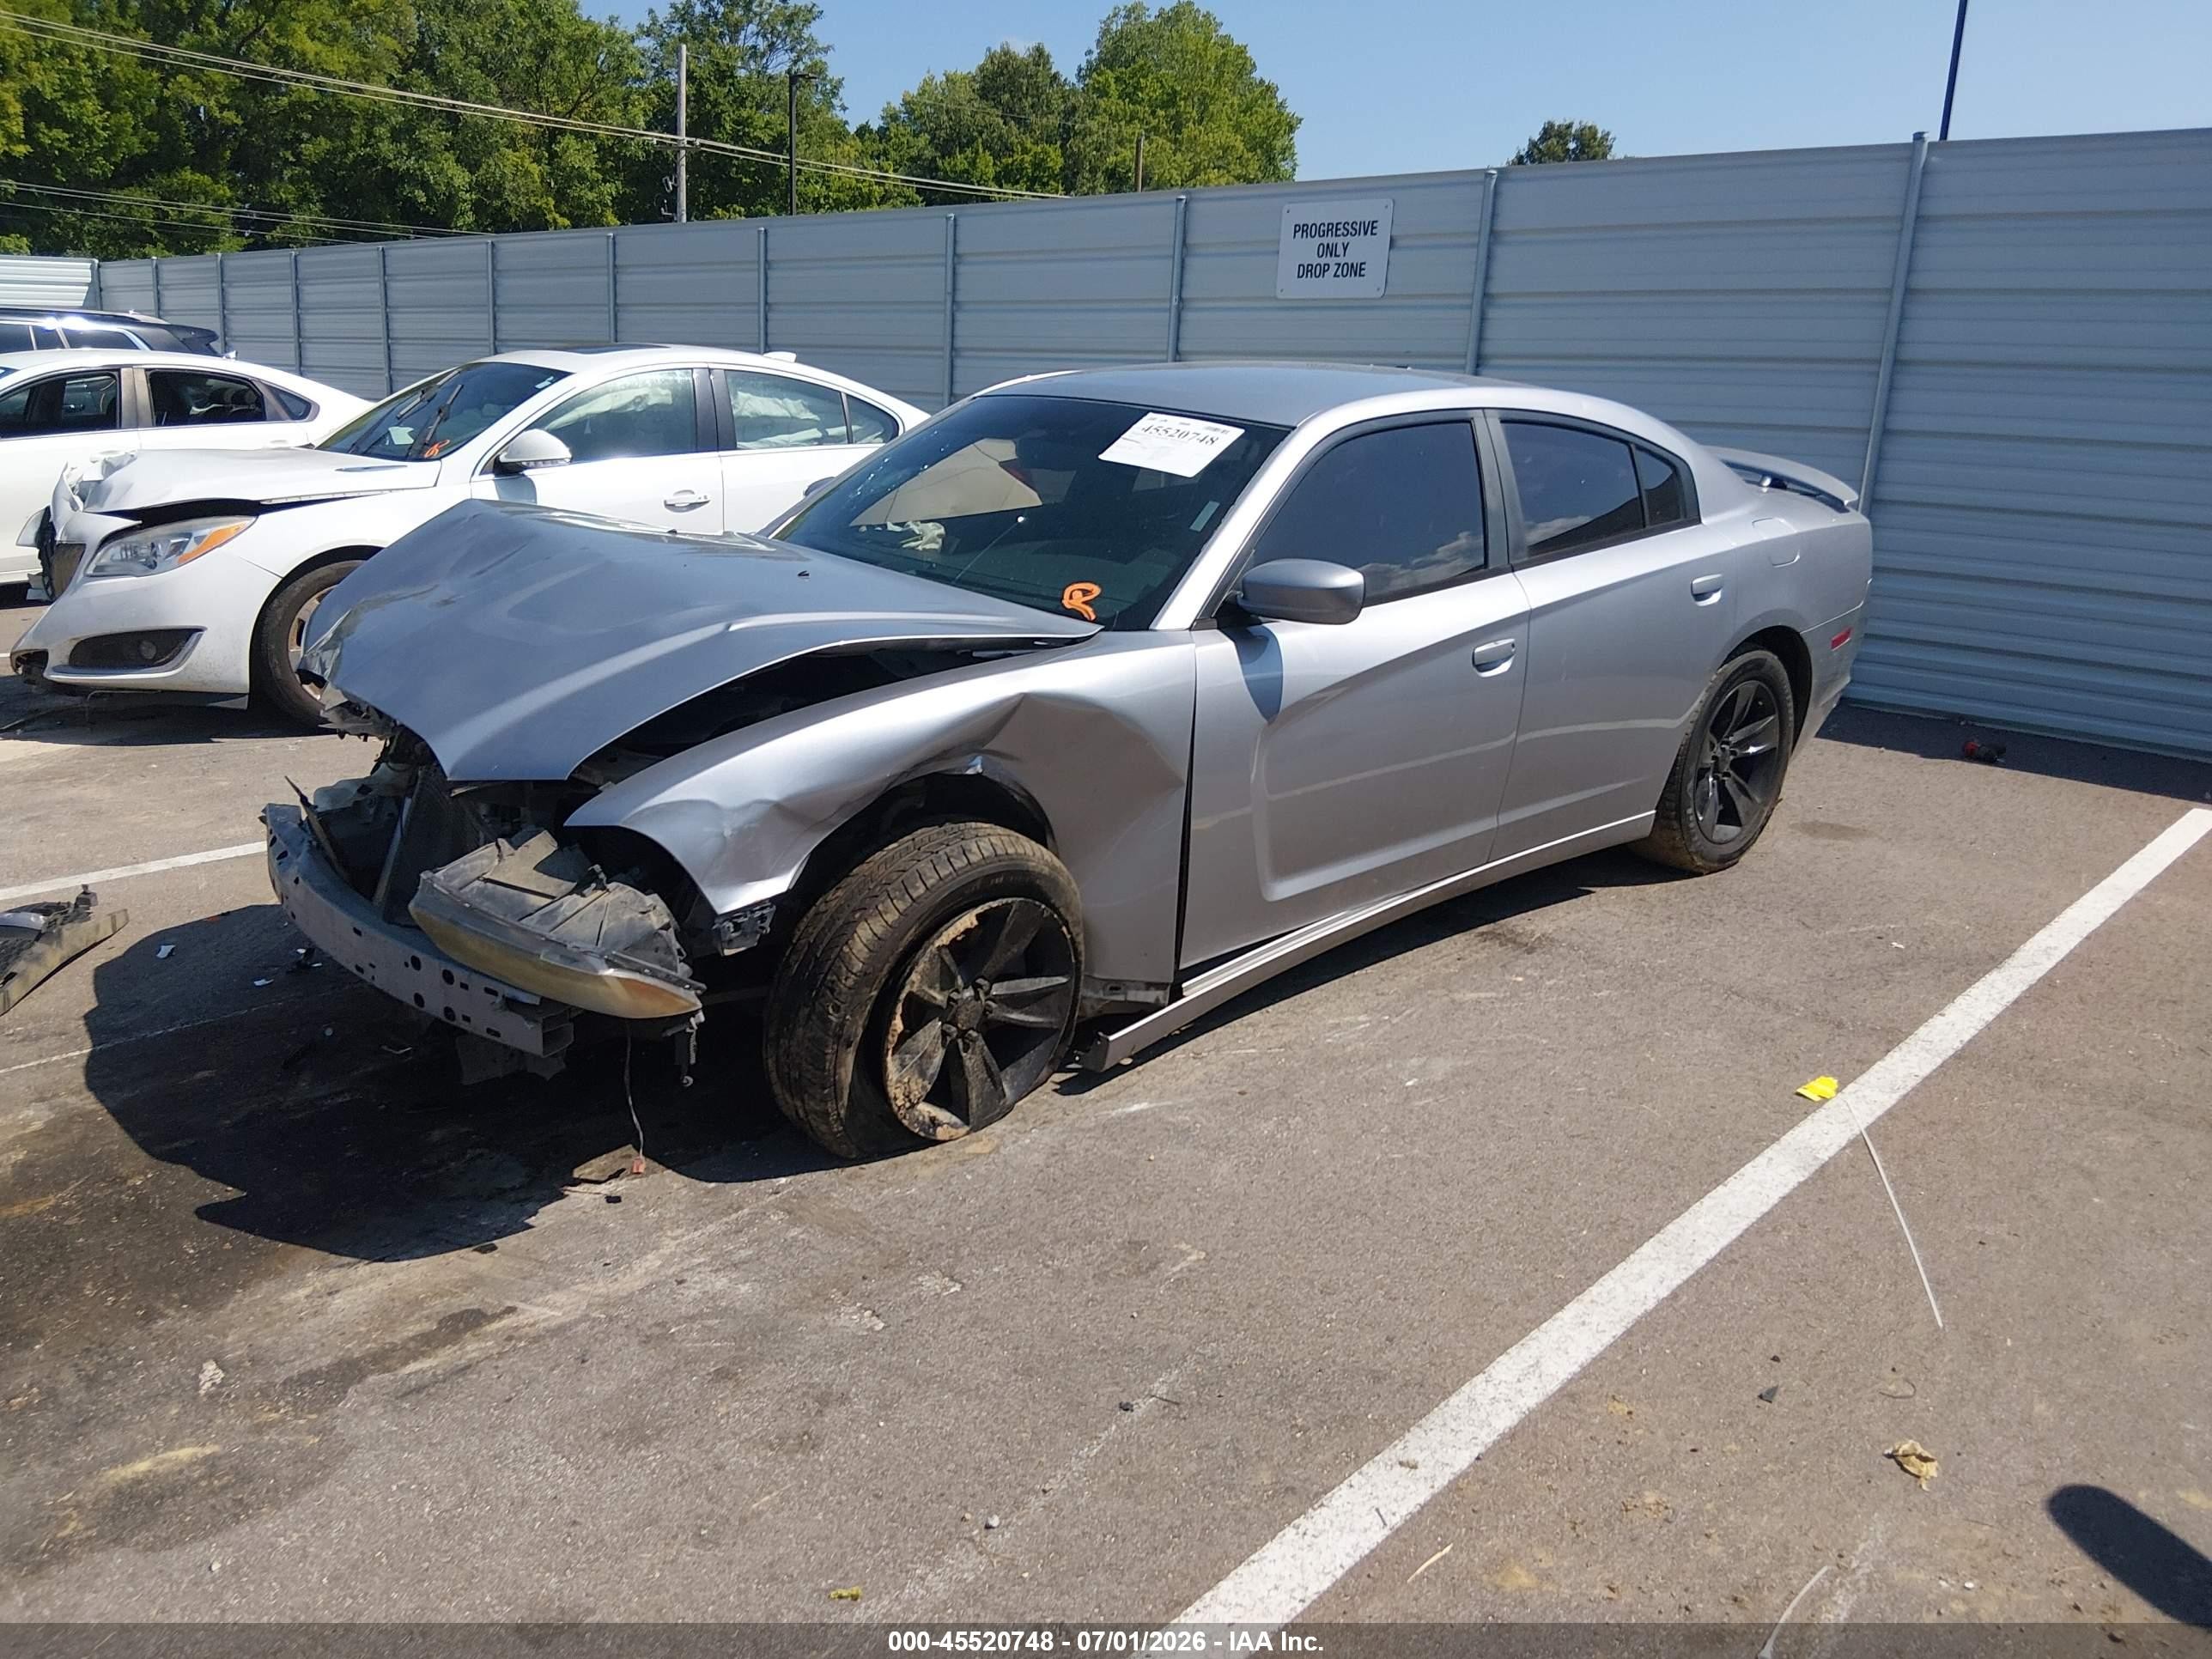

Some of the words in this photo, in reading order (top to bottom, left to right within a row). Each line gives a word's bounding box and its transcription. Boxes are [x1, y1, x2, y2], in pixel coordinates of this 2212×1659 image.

[1293, 220, 1378, 240] PROGRESSIVE
[1316, 241, 1350, 258] ONLY
[1297, 263, 1330, 279] DROP
[1333, 261, 1366, 277] ZONE
[1142, 424, 1219, 446] 45520748
